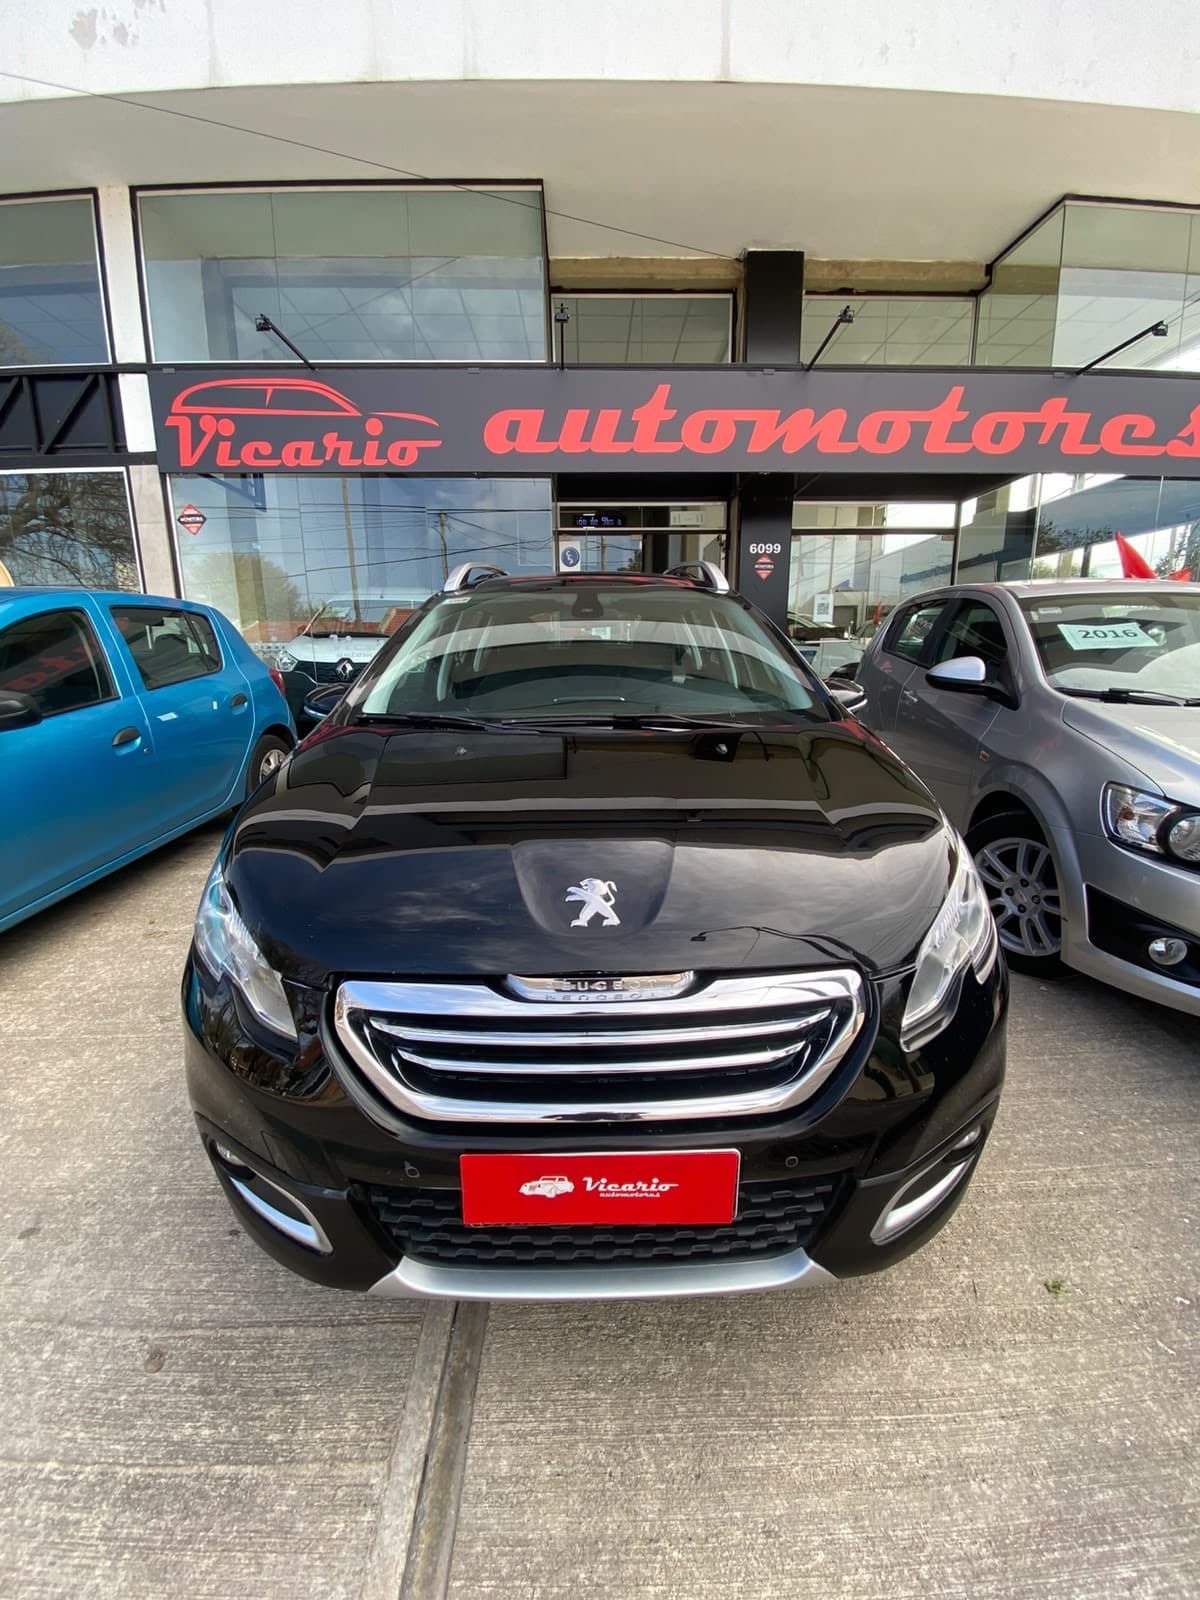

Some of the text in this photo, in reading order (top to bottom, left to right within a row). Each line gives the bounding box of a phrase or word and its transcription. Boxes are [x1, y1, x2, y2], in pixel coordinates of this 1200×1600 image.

[165, 415, 442, 467] Vicario
[749, 543, 782, 554] 6099
[1078, 629, 1138, 639] 2016
[582, 1176, 679, 1192] Vicario
